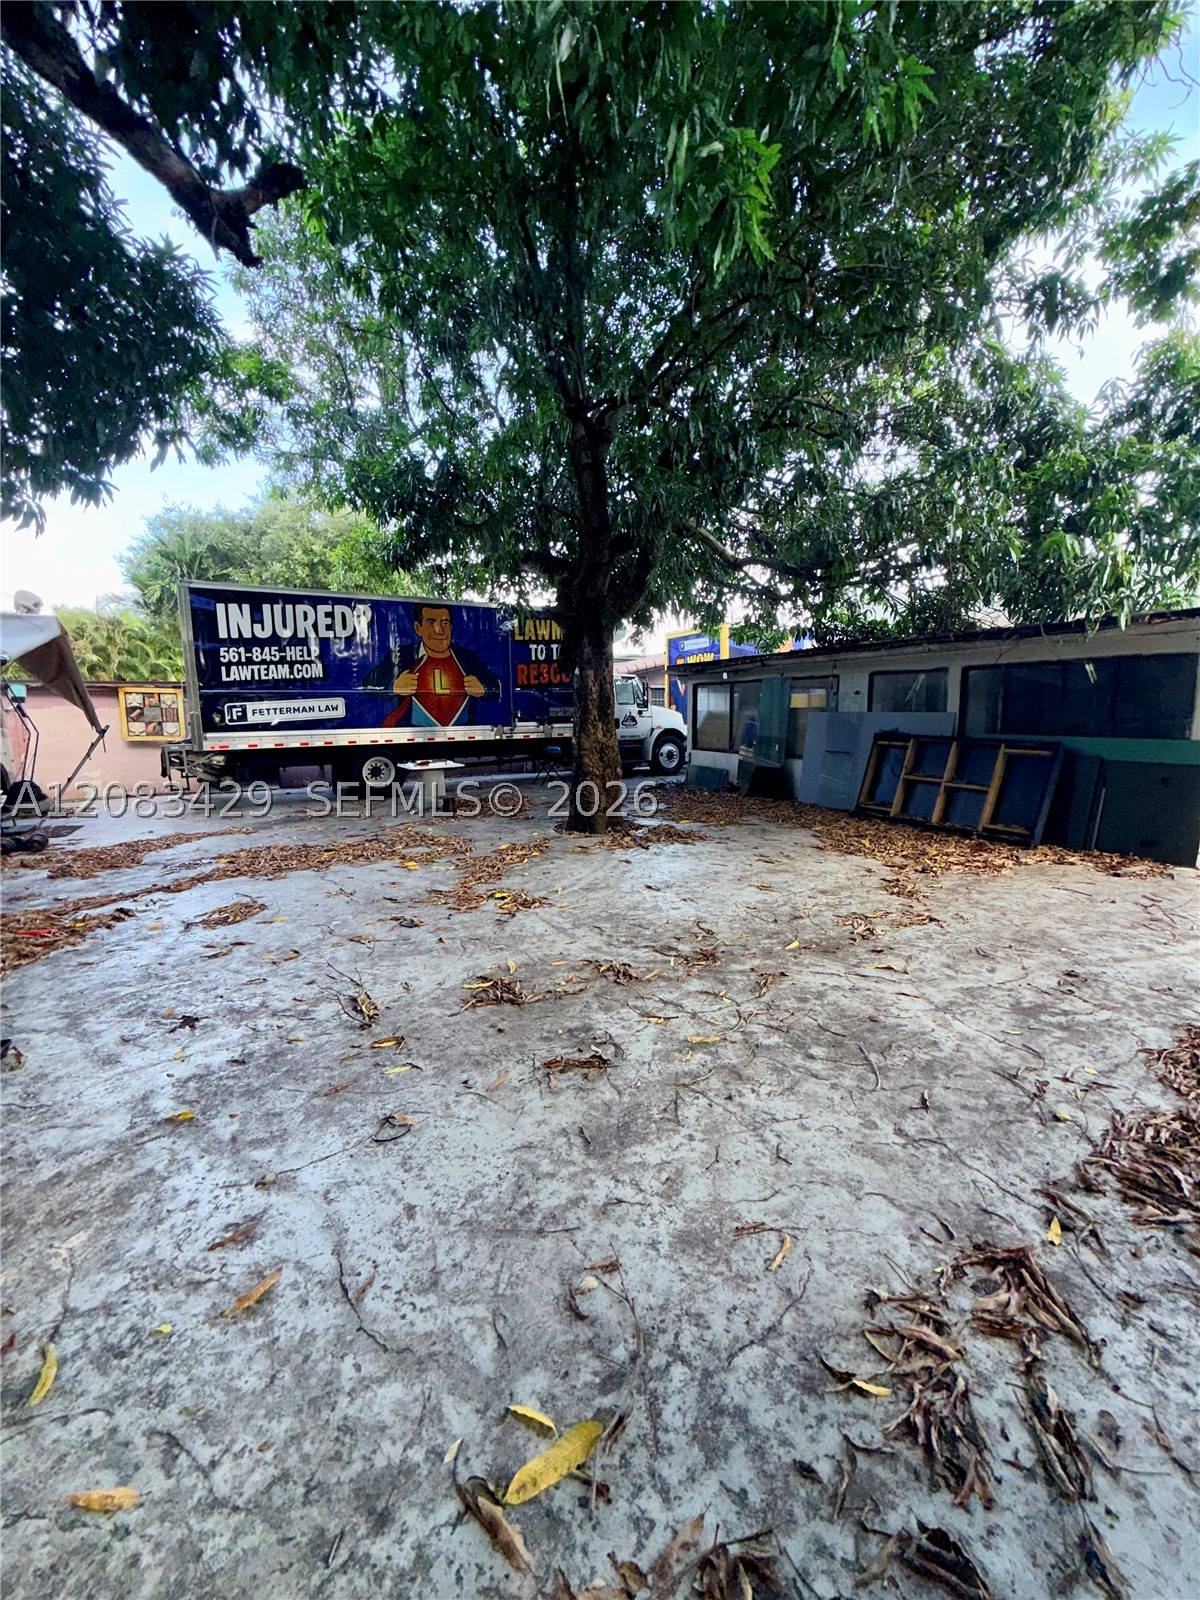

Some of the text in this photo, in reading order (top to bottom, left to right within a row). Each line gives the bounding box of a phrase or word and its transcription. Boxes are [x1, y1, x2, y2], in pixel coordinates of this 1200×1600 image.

[219, 646, 320, 663] 561-845-HELP
[529, 643, 546, 661] TO
[221, 663, 323, 682] LAWTEAM.COM
[252, 705, 315, 717] FETTERMAN
[318, 704, 339, 713] LAW
